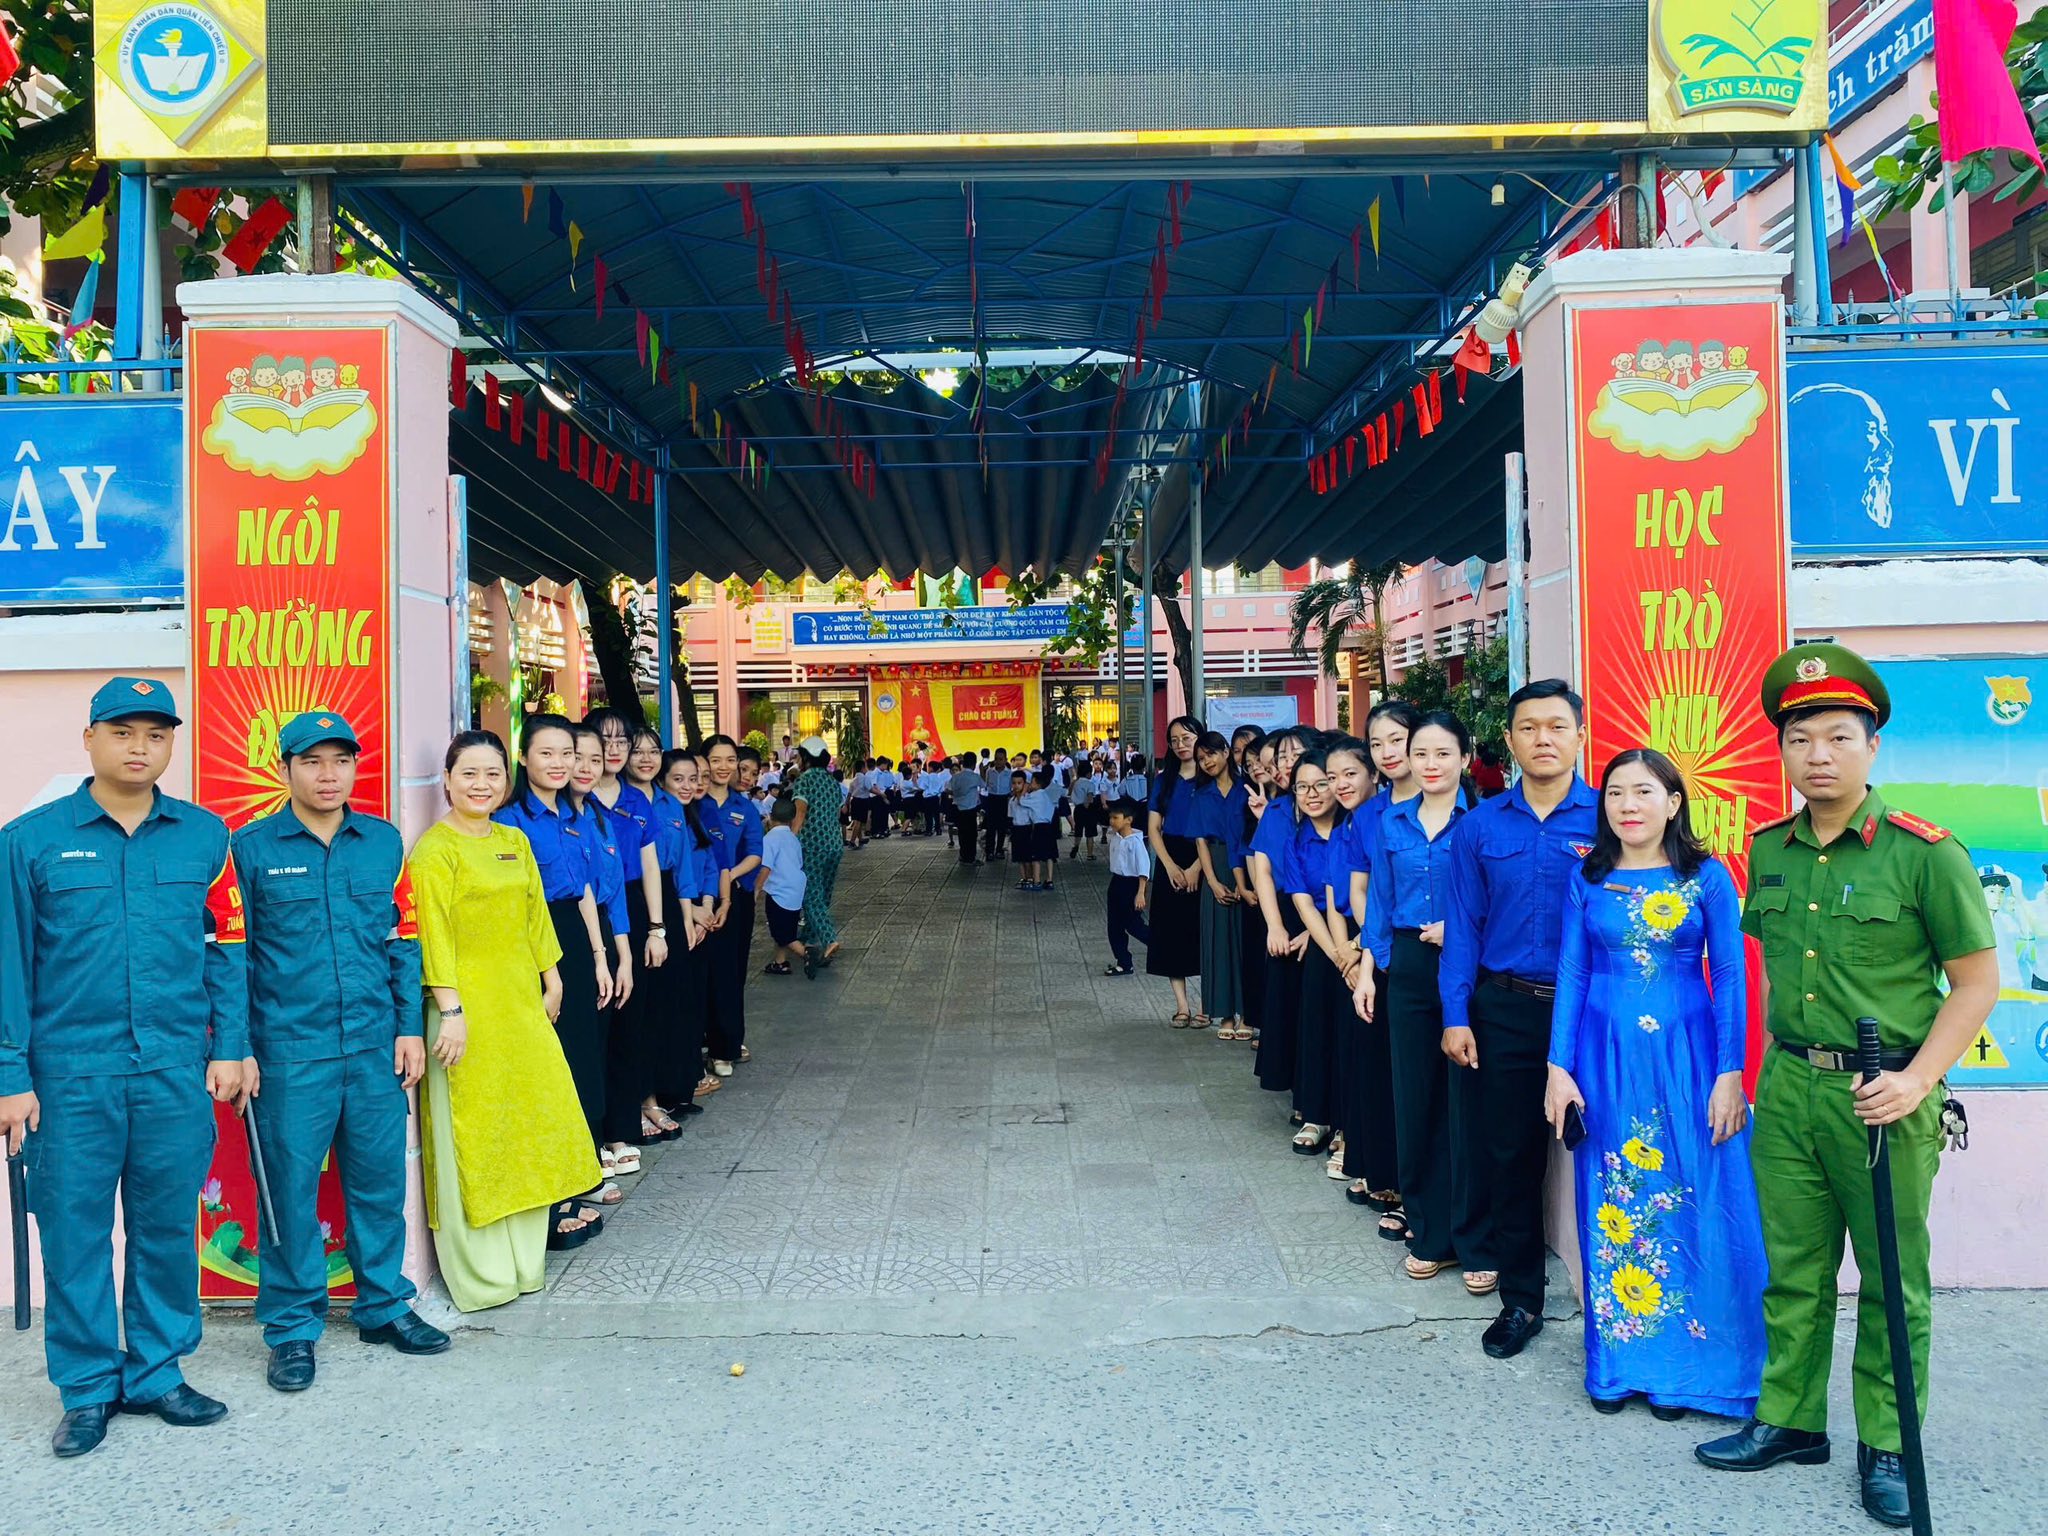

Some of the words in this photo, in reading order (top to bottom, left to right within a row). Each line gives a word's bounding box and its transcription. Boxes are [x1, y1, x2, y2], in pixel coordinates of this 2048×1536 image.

[1738, 79, 1795, 99] SÀNG
[1928, 387, 2021, 506] VÌ
[236, 495, 340, 566] NGÔI
[1635, 485, 1724, 559] HỌC
[205, 597, 374, 667] TRƯỜNG
[892, 614, 908, 622] NAM
[899, 623, 922, 631] QUANG
[1640, 578, 1723, 651] TRÒ
[979, 691, 998, 707] LỄ
[1650, 694, 1719, 753] VUI
[1689, 795, 1748, 855] NH
